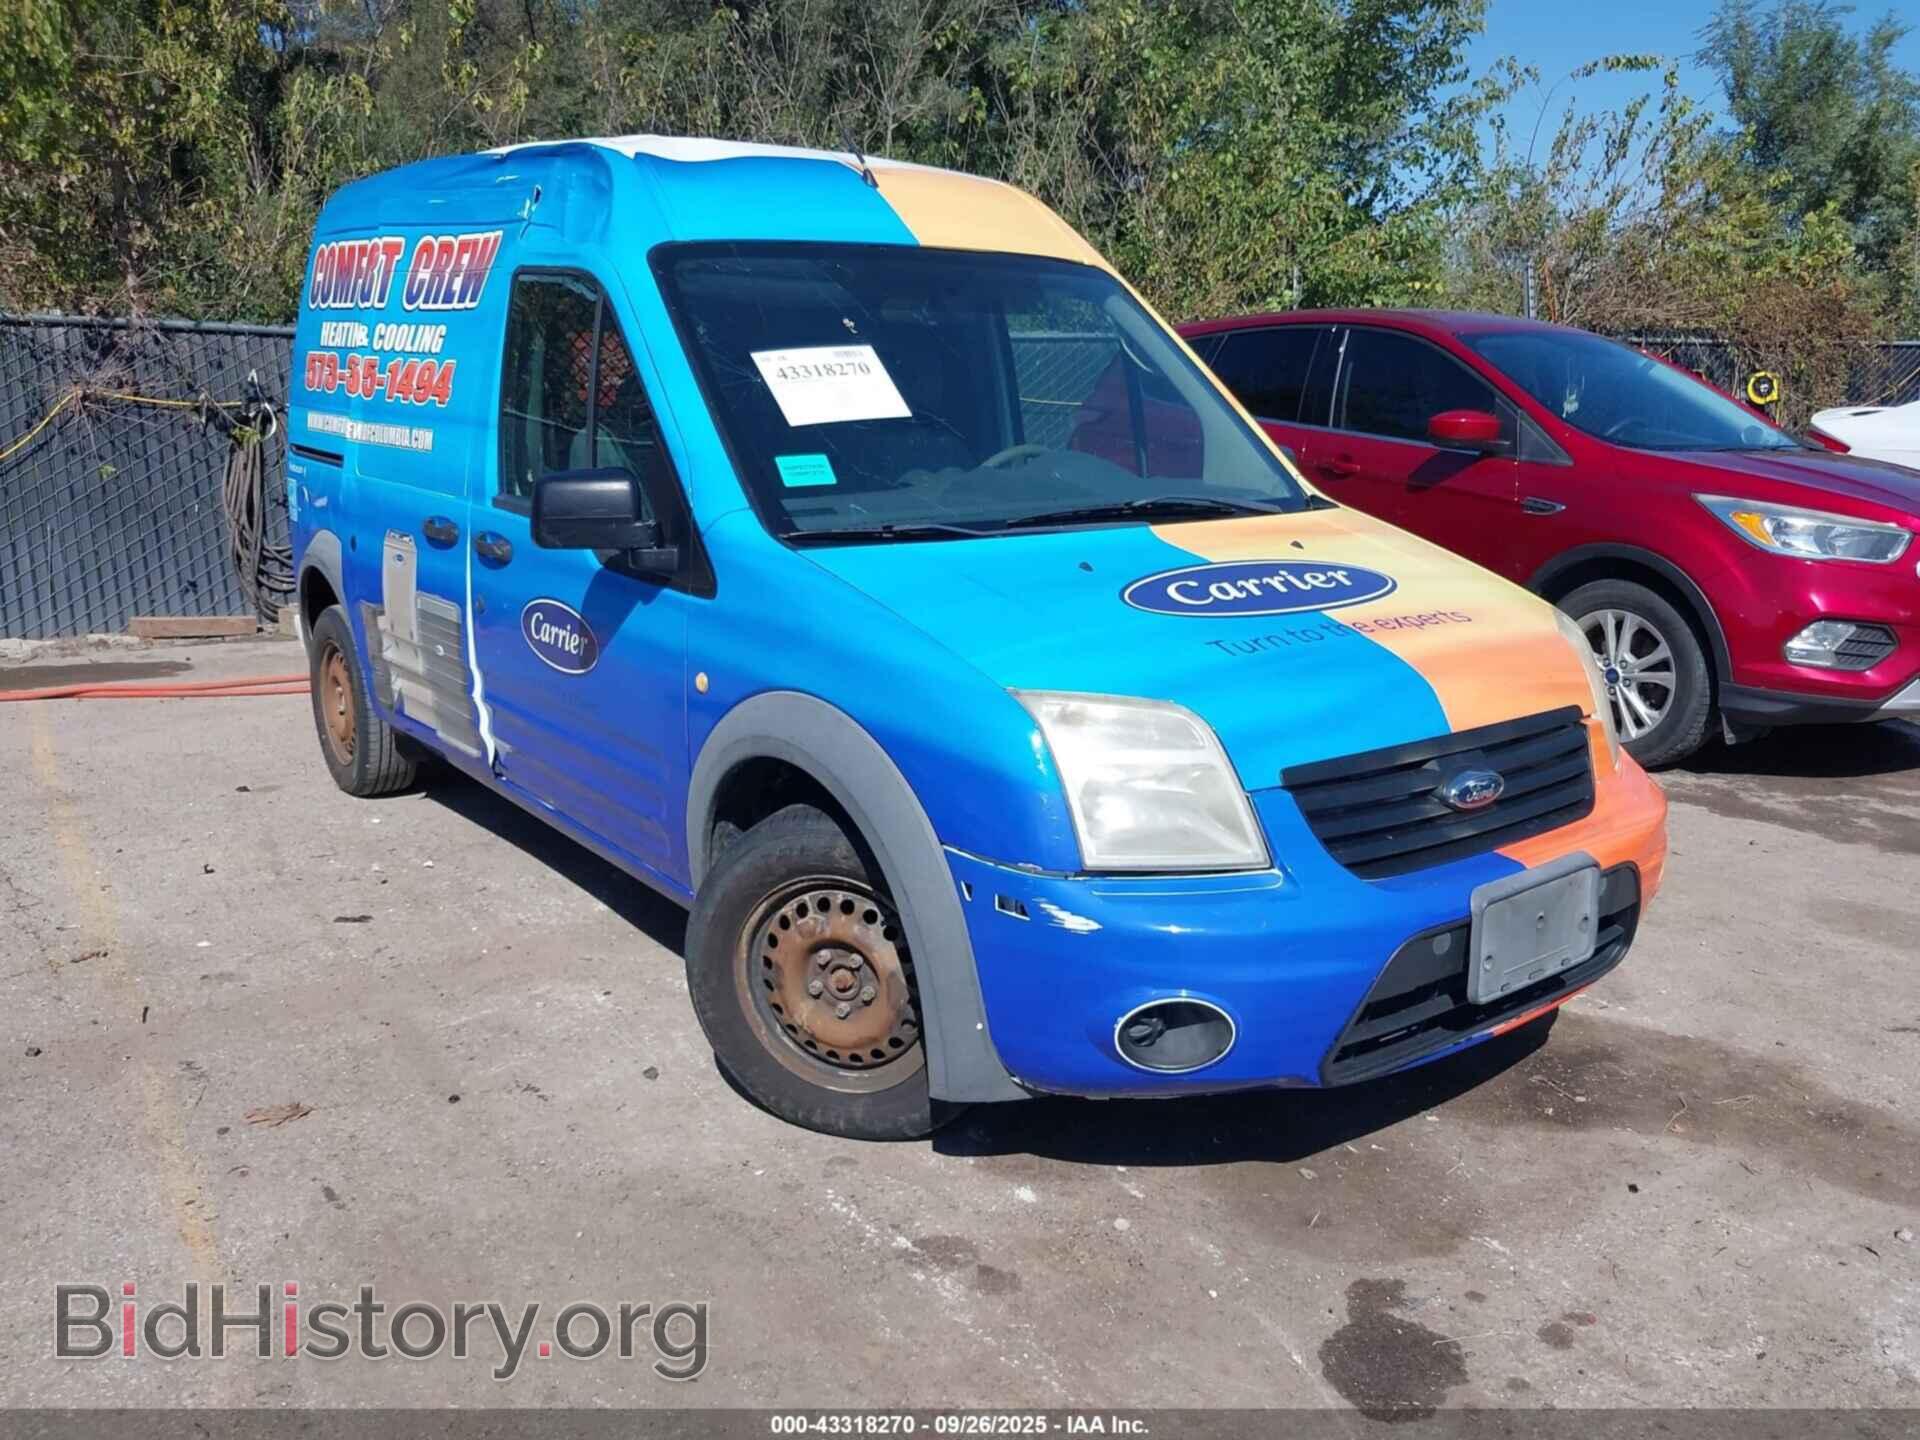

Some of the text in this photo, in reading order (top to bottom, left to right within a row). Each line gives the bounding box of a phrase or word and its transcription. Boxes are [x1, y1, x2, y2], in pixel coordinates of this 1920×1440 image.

[403, 230, 503, 310] CREW
[373, 323, 447, 352] COOLING
[776, 362, 872, 380] 43318270
[1165, 568, 1353, 606] Carrier
[530, 611, 588, 657] Carrier
[1206, 609, 1473, 657] Turn to the experts
